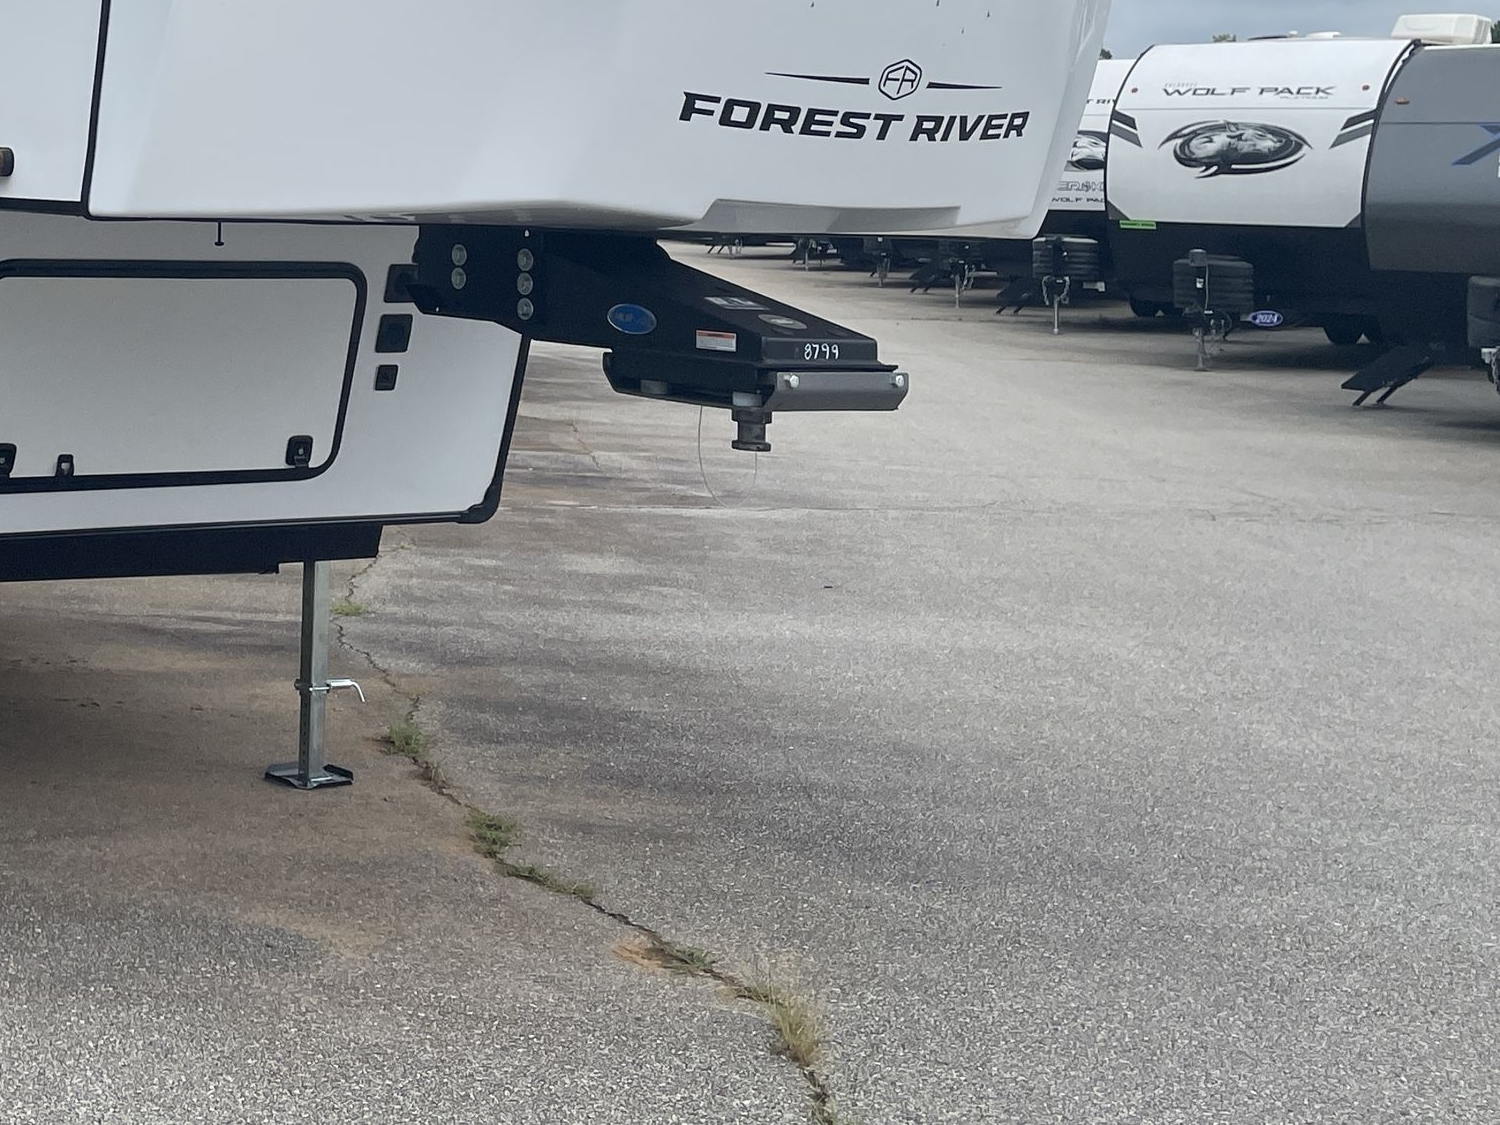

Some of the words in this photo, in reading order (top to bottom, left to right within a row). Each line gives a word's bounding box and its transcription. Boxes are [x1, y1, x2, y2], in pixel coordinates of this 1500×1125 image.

[1162, 86, 1251, 97] WOLF
[1257, 85, 1337, 96] PACK
[678, 91, 906, 141] FOREST
[908, 110, 1031, 143] RIVER
[803, 343, 840, 362] 8799
